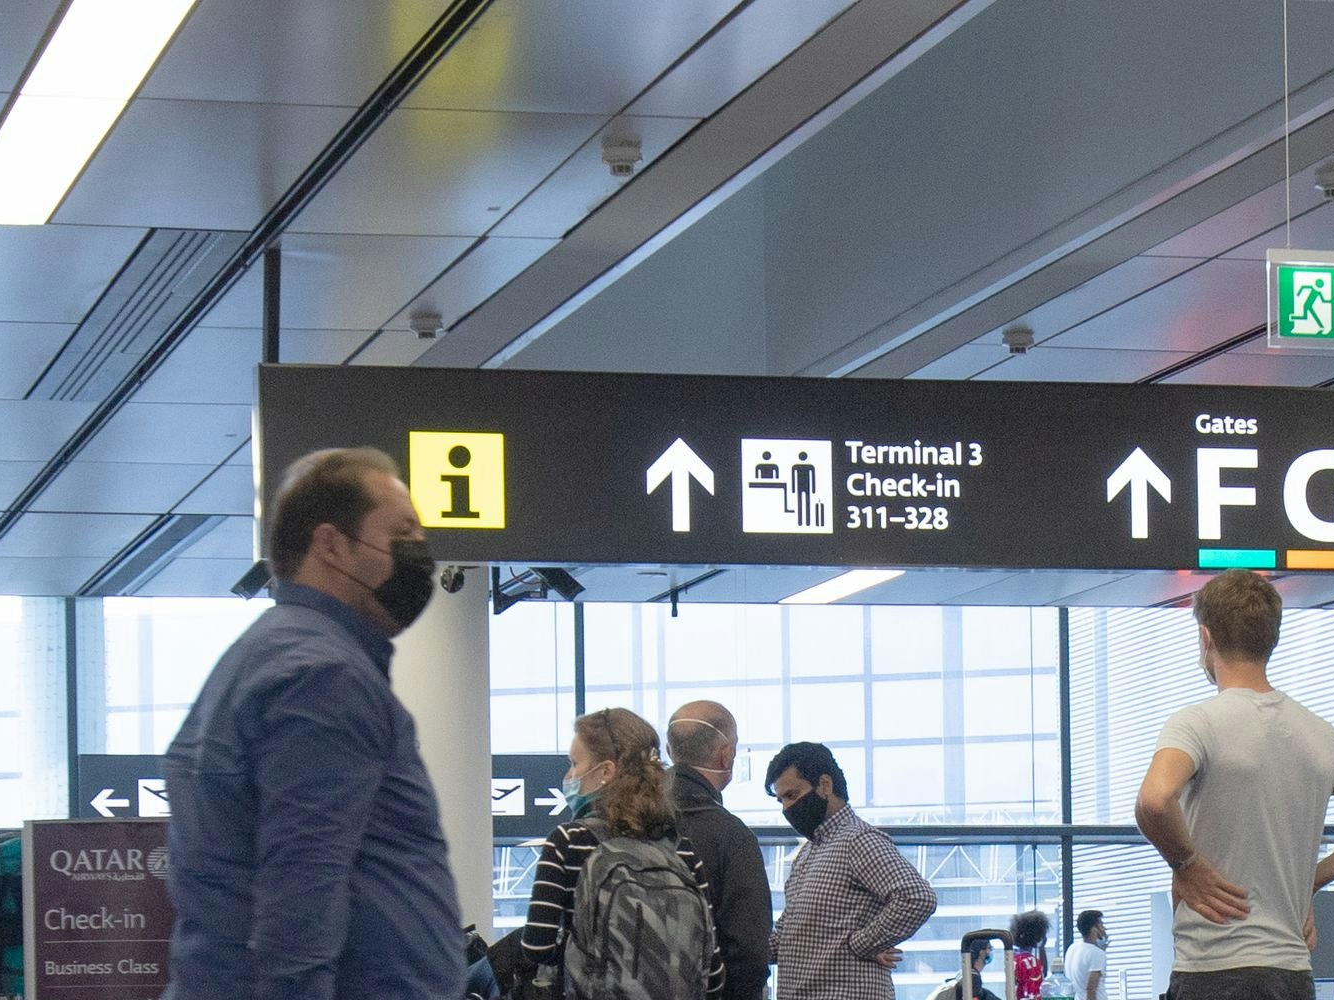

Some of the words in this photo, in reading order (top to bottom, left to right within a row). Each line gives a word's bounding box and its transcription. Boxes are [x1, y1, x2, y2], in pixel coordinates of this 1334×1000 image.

[1195, 414, 1259, 436] Gates
[845, 439, 962, 466] Terminal
[968, 442, 983, 466] 3
[846, 472, 961, 498] Check-in
[49, 849, 145, 876] QATAR
[44, 907, 146, 930] Check-in
[44, 960, 113, 976] Business
[117, 959, 160, 975] Class
